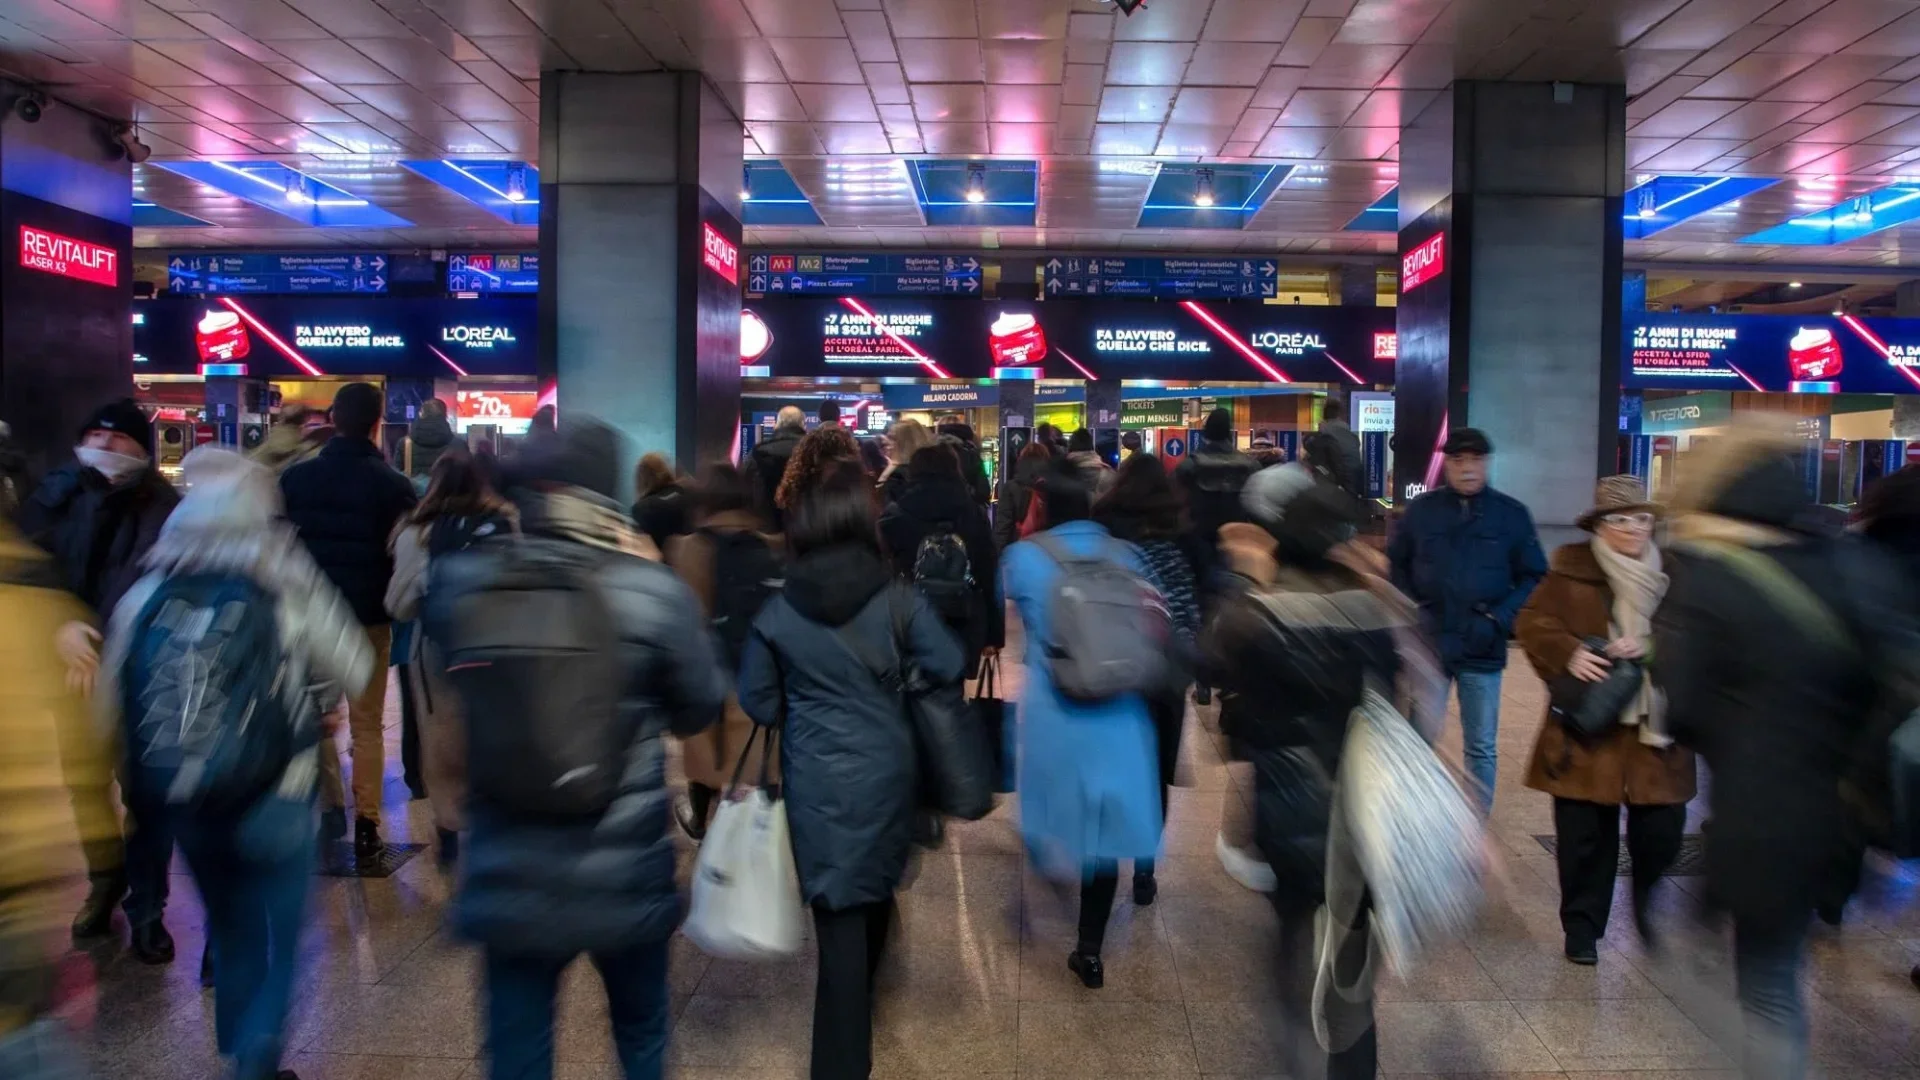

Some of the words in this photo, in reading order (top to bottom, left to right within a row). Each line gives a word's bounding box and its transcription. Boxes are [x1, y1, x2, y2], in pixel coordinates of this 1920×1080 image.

[24, 230, 115, 272] REVITALIFT
[705, 227, 737, 270] REVITALIFT
[1404, 236, 1442, 278] REVITALIFT
[24, 254, 53, 269] LASER
[55, 261, 66, 273] X3
[473, 259, 491, 268] M1
[499, 259, 518, 269] M2
[772, 260, 792, 269] M1
[800, 260, 819, 269] M2
[1222, 284, 1237, 292] WC
[824, 314, 837, 325] -7
[890, 315, 932, 325] RUGHE
[296, 326, 312, 336] FA
[314, 326, 371, 336] DAVVERO
[443, 325, 516, 341] L'ORÉAL
[825, 325, 839, 335] IN
[842, 325, 871, 335] SOLI
[1096, 330, 1112, 340] FA
[1115, 330, 1176, 340] DAVVERO
[1633, 327, 1646, 337] -7
[1648, 327, 1679, 338] ANNI
[1681, 328, 1694, 338] DI
[1696, 328, 1737, 339] RUGHE
[296, 337, 344, 346] QUELLO
[345, 337, 370, 346] CHE
[373, 337, 405, 346] DICE.
[1252, 332, 1327, 348] L'ORÉAL
[1633, 337, 1647, 348] IN
[1650, 338, 1679, 348] SOLI
[1681, 339, 1690, 348] 6
[1096, 341, 1146, 351] QUELLO
[1149, 341, 1175, 351] CHE
[1177, 342, 1211, 352] DICE.
[1275, 347, 1303, 355] PARIS
[1888, 345, 1904, 356] FA
[1633, 350, 1671, 358] ACCETTA
[1686, 351, 1710, 359] SFIDA
[1645, 357, 1680, 366] L'ORÉAL
[1682, 358, 1709, 366] PARIS.
[923, 394, 947, 402] MILANO
[948, 392, 978, 401] CADORNA
[472, 396, 512, 415] -70%
[1127, 401, 1155, 410] TICKETS
[1364, 404, 1380, 414] ria
[1657, 405, 1700, 421] TRENORD
[1147, 414, 1178, 423] MENSILI
[1364, 417, 1383, 425] Invia
